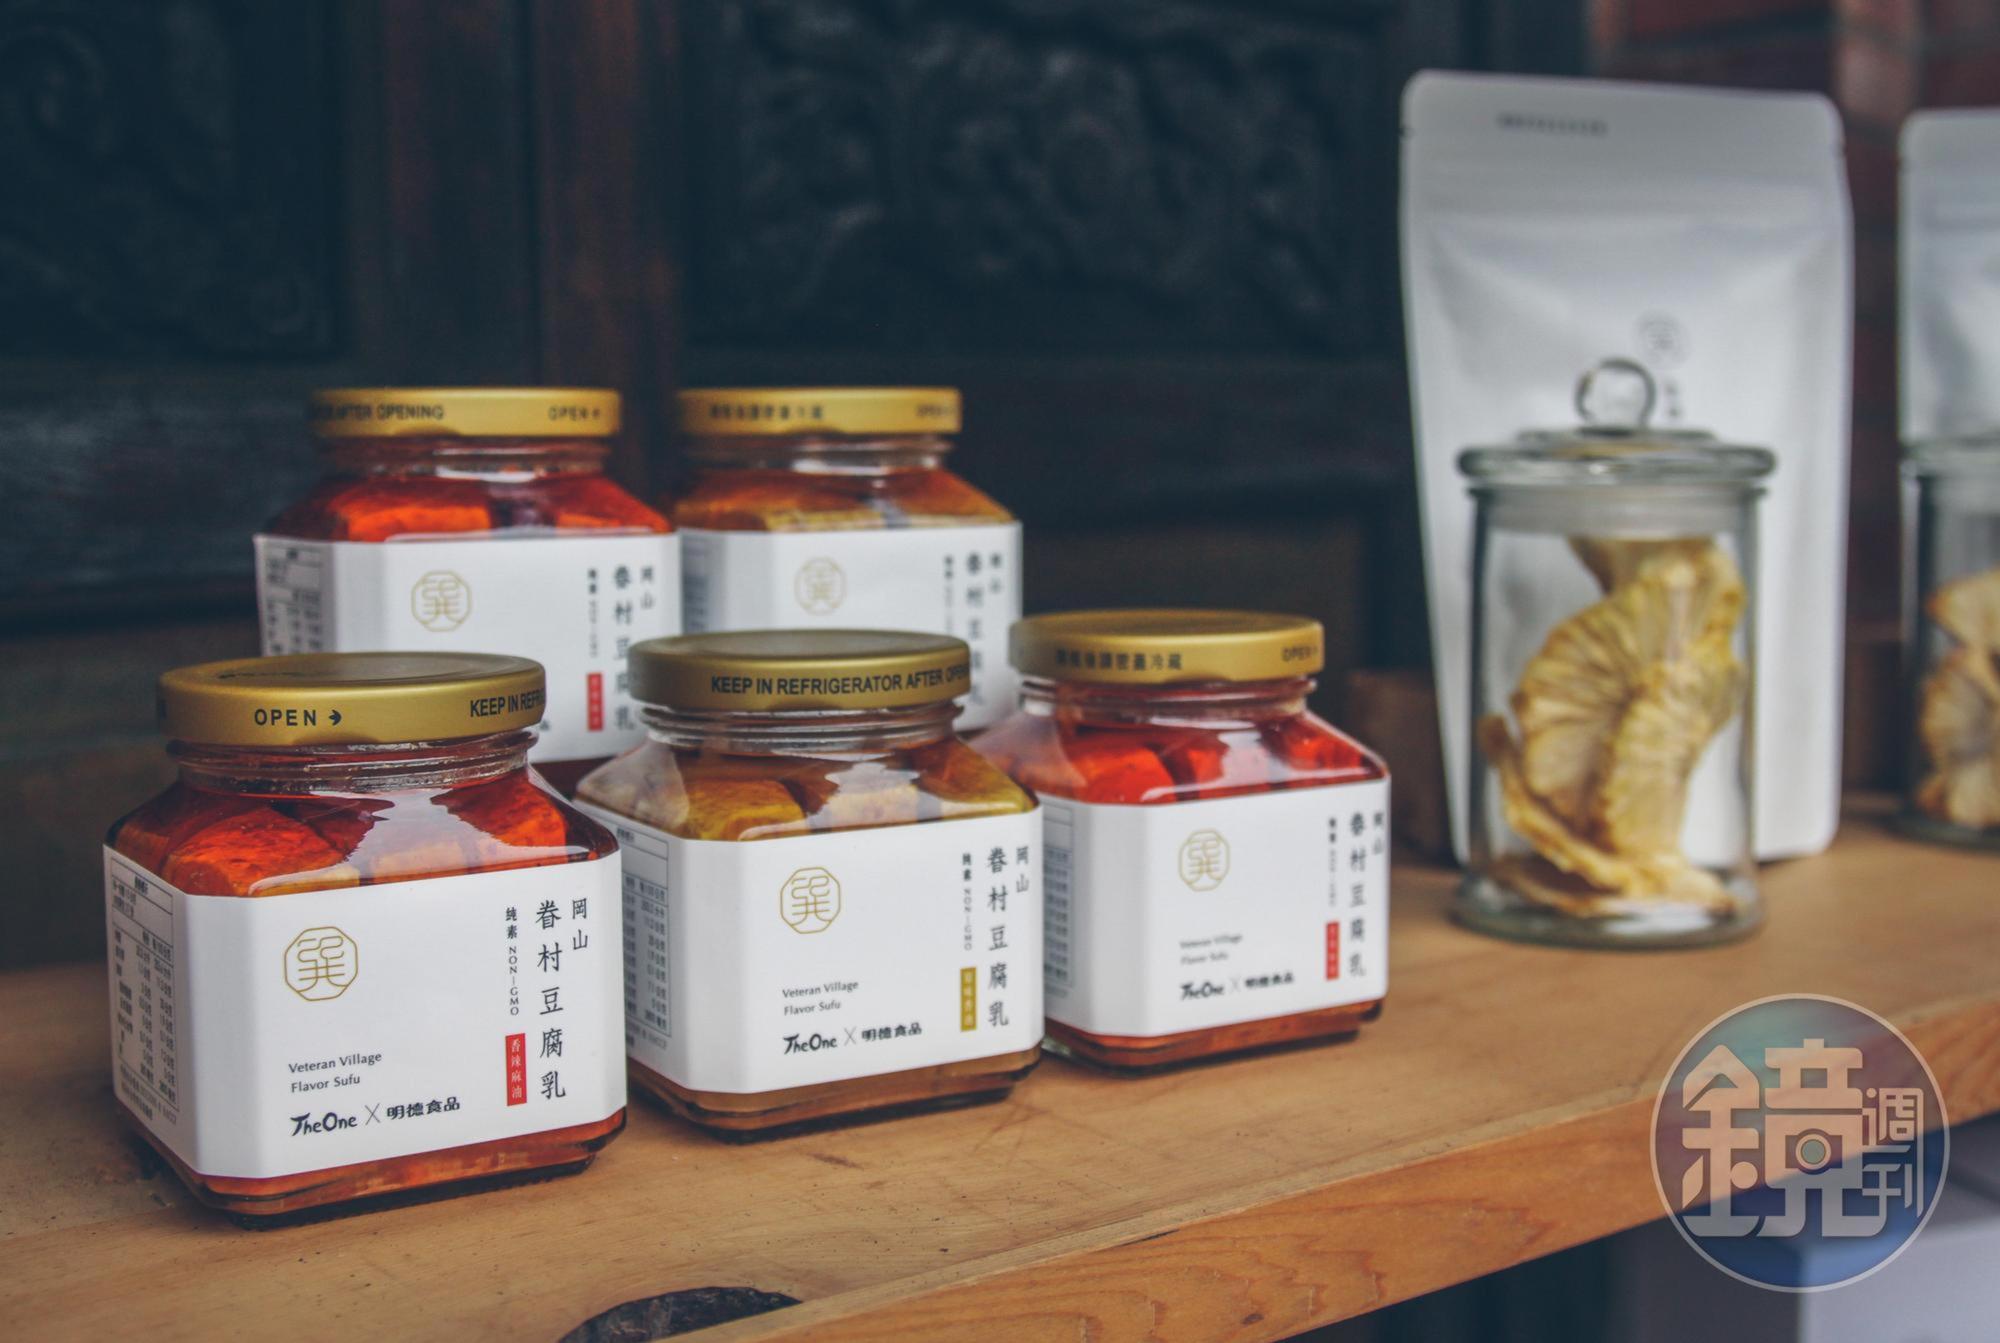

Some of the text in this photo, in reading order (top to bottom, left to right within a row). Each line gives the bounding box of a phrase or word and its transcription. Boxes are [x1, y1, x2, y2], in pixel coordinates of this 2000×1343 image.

[377, 404, 444, 420] OPENING
[711, 676, 752, 693] KEEP
[757, 678, 772, 694] IN
[778, 675, 901, 695] REFRIGERATOR
[906, 669, 942, 689] AFTER
[470, 696, 505, 717] KEEP
[508, 694, 518, 713] IN
[254, 708, 317, 726] OPEN
[571, 897, 589, 951] 岡山
[782, 981, 859, 998] Veteran Village
[535, 900, 566, 1100] 眷村豆腐乳
[784, 1000, 841, 1016] Flavor Sufu
[289, 1053, 382, 1073] Veteran Village
[291, 1073, 361, 1093] Flavor Sufu
